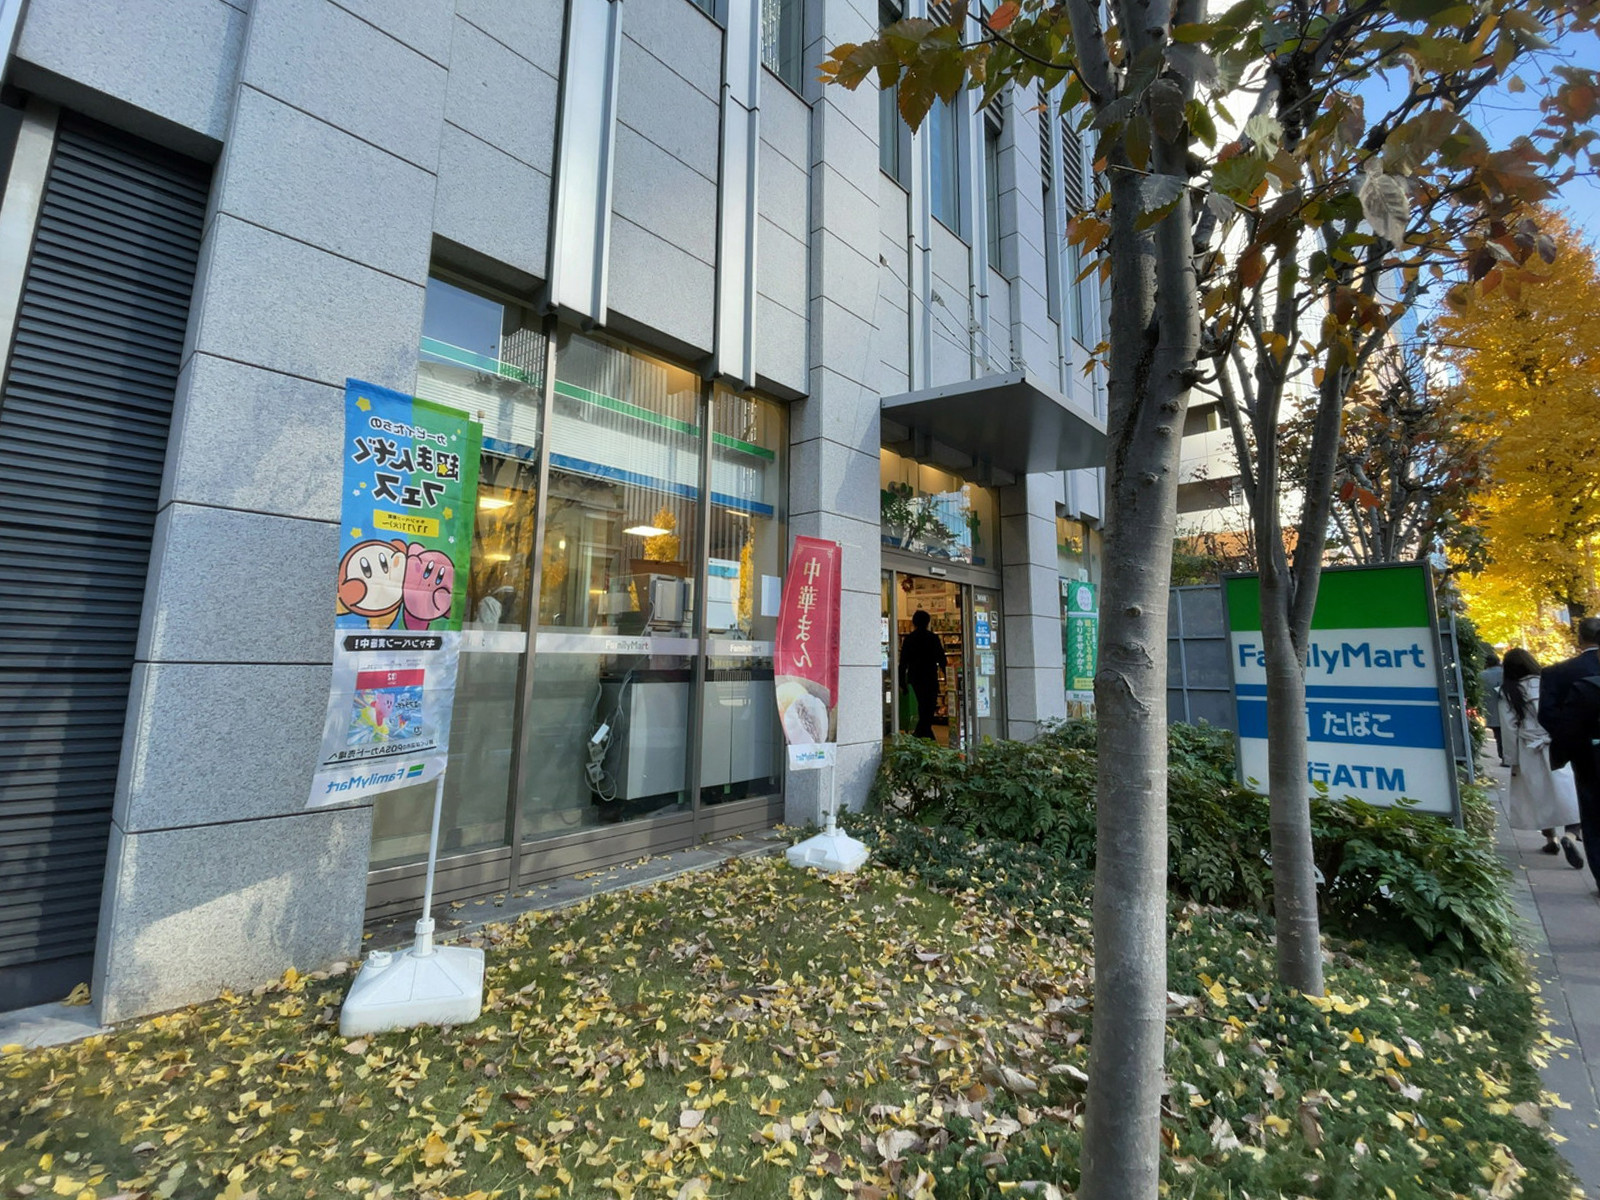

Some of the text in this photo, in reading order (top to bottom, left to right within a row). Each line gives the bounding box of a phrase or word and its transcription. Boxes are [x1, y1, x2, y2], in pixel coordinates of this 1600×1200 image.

[1238, 642, 1426, 675] FailyMart
[1322, 710, 1395, 738] たばこ
[1307, 761, 1406, 792] 行ATM
